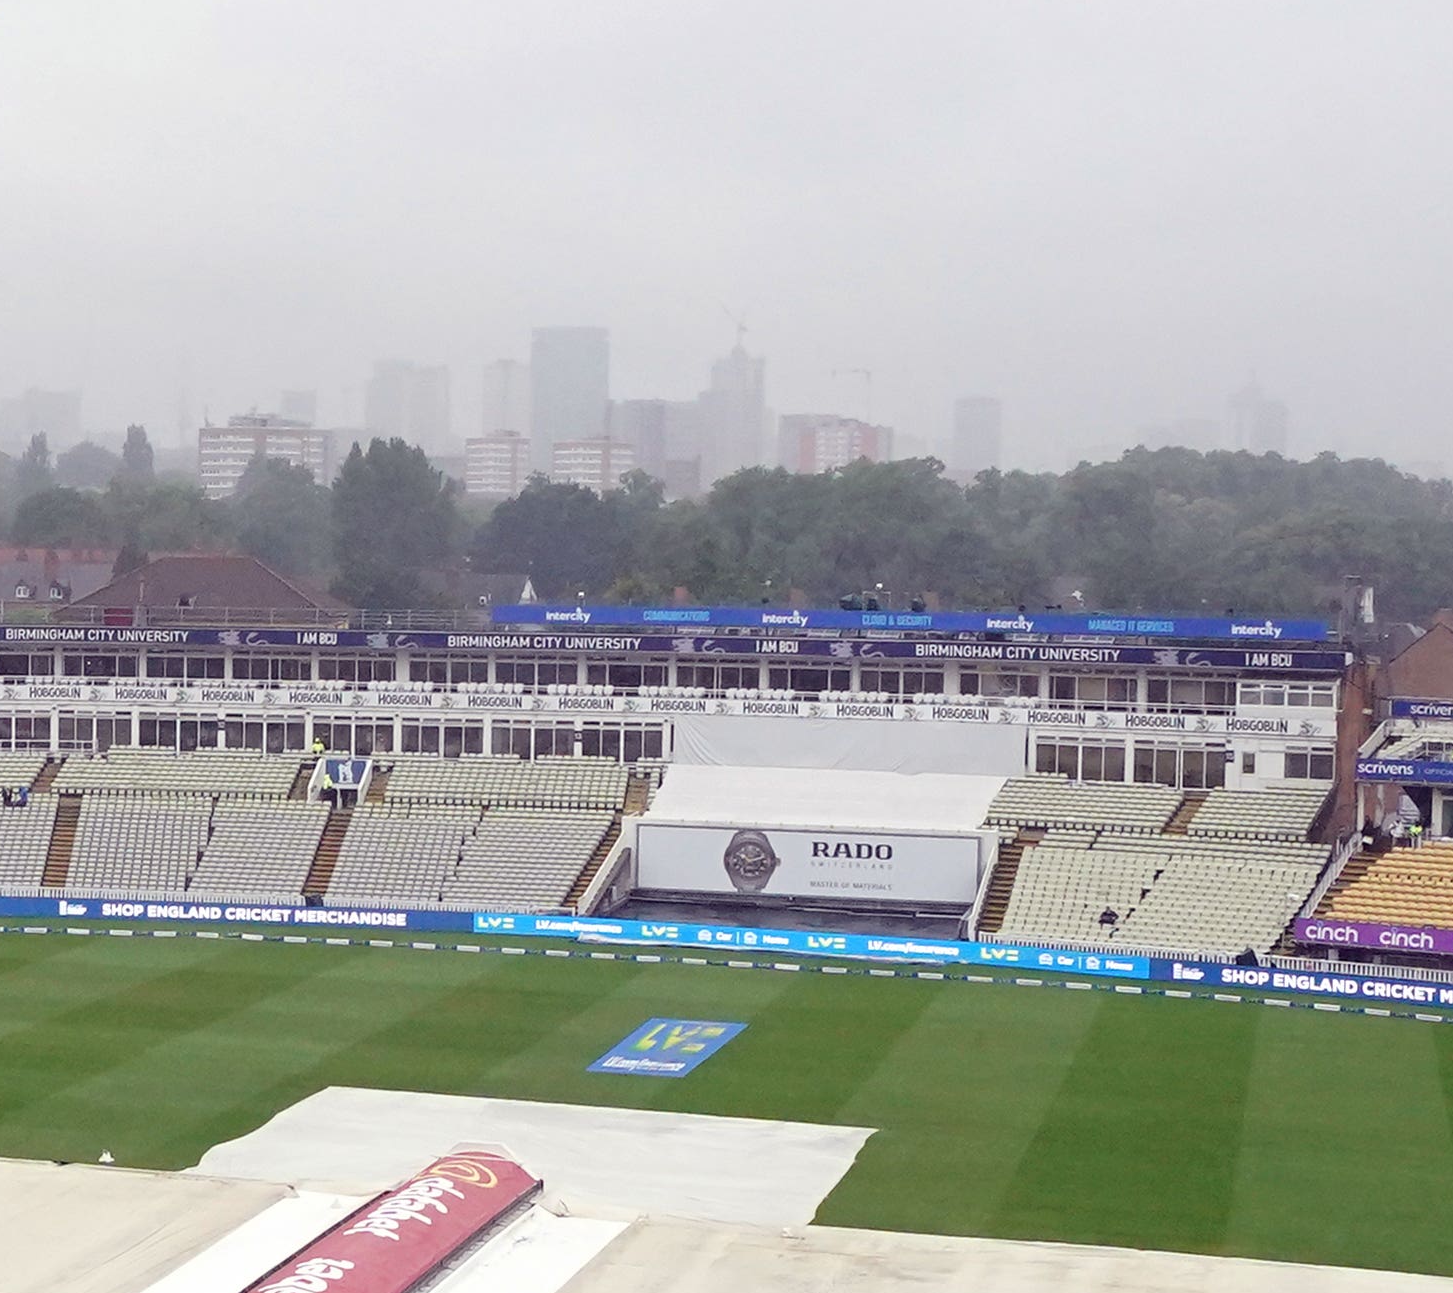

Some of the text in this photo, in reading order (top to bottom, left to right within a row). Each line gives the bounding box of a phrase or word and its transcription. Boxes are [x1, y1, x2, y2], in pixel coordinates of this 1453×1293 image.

[5, 629, 189, 642] BIRMINGHAM CITY UNIVERSITY
[915, 644, 1120, 663] BIRMINGHAM CITY UNIVERSITY
[29, 686, 81, 698] HOBGOBLIN
[290, 692, 342, 704] HOBGOBLIN
[932, 708, 989, 722] HOBGOBLIN
[1226, 717, 1288, 734] HOBGOBLIN
[1357, 762, 1413, 776] scrivens
[812, 841, 892, 860] RADO
[102, 903, 407, 926] SHOP ENGLAND CRICKET MERCHANDISE
[1306, 920, 1358, 943] cinch
[1379, 927, 1433, 950] cinch
[1222, 969, 1268, 985] SHOP
[1273, 972, 1358, 995] ENGLAND
[1362, 980, 1436, 1002] CRICKET
